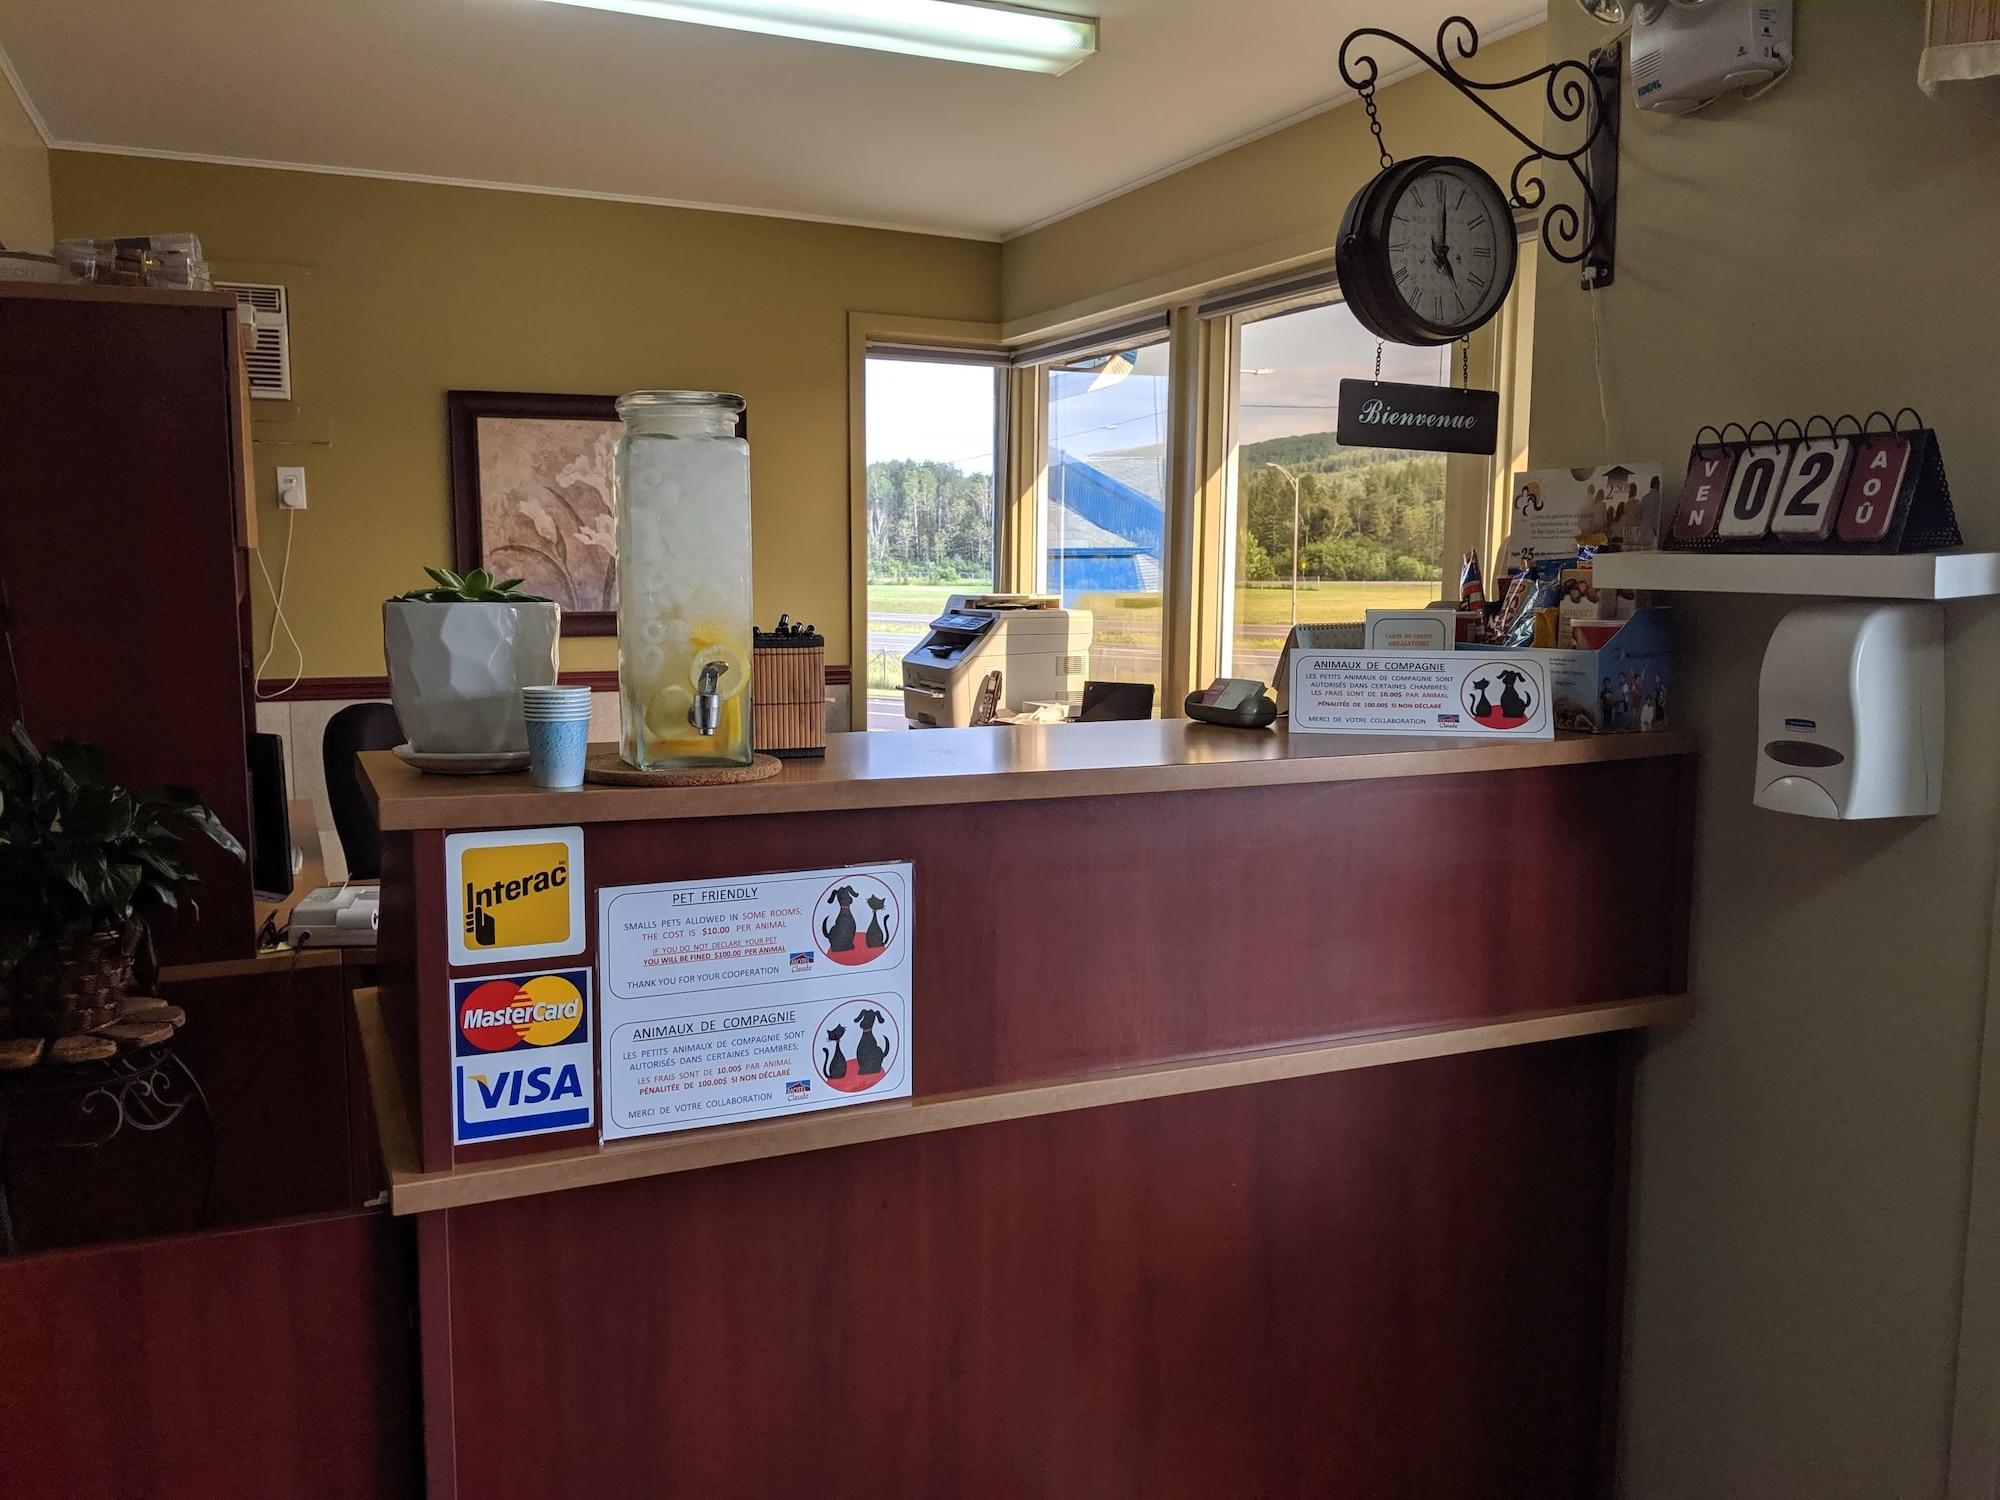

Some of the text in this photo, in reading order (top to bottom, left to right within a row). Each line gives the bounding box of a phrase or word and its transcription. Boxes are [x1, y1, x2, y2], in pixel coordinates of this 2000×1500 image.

[1638, 80, 1662, 96] IDEAL
[1358, 399, 1478, 429] Bienvenue
[1688, 461, 1719, 526] VEN
[1733, 452, 1834, 520] 02
[1855, 450, 1887, 524] AOÛ
[1522, 547, 1534, 561] 25
[1313, 661, 1445, 671] ANIMAUX DE COMPAGNIE
[1318, 700, 1350, 708] PÉNALITÉE
[466, 865, 567, 912] Interac
[672, 888, 758, 904] PET FRIENDLY
[624, 919, 657, 931] SMALLS
[661, 918, 681, 928] PETS
[686, 914, 726, 925] ALLOWED
[742, 911, 766, 920] SOME
[643, 933, 658, 941] THE
[663, 930, 683, 939] COST
[702, 926, 730, 936] $10.00
[736, 924, 751, 932] PER
[755, 921, 786, 930] ANIMAL
[643, 958, 659, 966] YOU
[690, 953, 711, 961] FINED
[714, 950, 741, 960] $100.00
[759, 945, 786, 954] ANIMAL
[662, 946, 678, 954] YOU
[680, 945, 690, 953] DO
[712, 940, 741, 949] DECLARE
[628, 966, 779, 989] THANK YOU FOR YOUR COOPERATION
[791, 965, 812, 973] Claude
[464, 999, 578, 1030] MasterCard
[633, 1011, 796, 1040] ANIMAUX DE COMPAGNIE
[623, 1031, 804, 1060] LES PETITS ANIMAUX DE COMPAGNIE SONT
[629, 1058, 675, 1071] AUTORISÉS
[680, 1055, 702, 1064] DANS
[706, 1049, 749, 1062] CERTAINES
[637, 1077, 650, 1085] LES
[654, 1074, 675, 1082] FRAIS
[679, 1070, 699, 1080] SONT
[704, 1068, 713, 1076] DE
[717, 1064, 741, 1074] 10.00$
[763, 1058, 792, 1068] ANIMAL
[470, 1064, 583, 1110] VISA
[639, 1083, 680, 1096] PÉNALITÉE
[684, 1082, 694, 1090] DE
[698, 1078, 727, 1088] 100.00$
[739, 1074, 756, 1082] NON
[759, 1069, 791, 1080] DÉCLARÉ
[628, 1093, 772, 1119] MERCI DE VOTRE COLLABORATION
[787, 1093, 809, 1102] Claude
